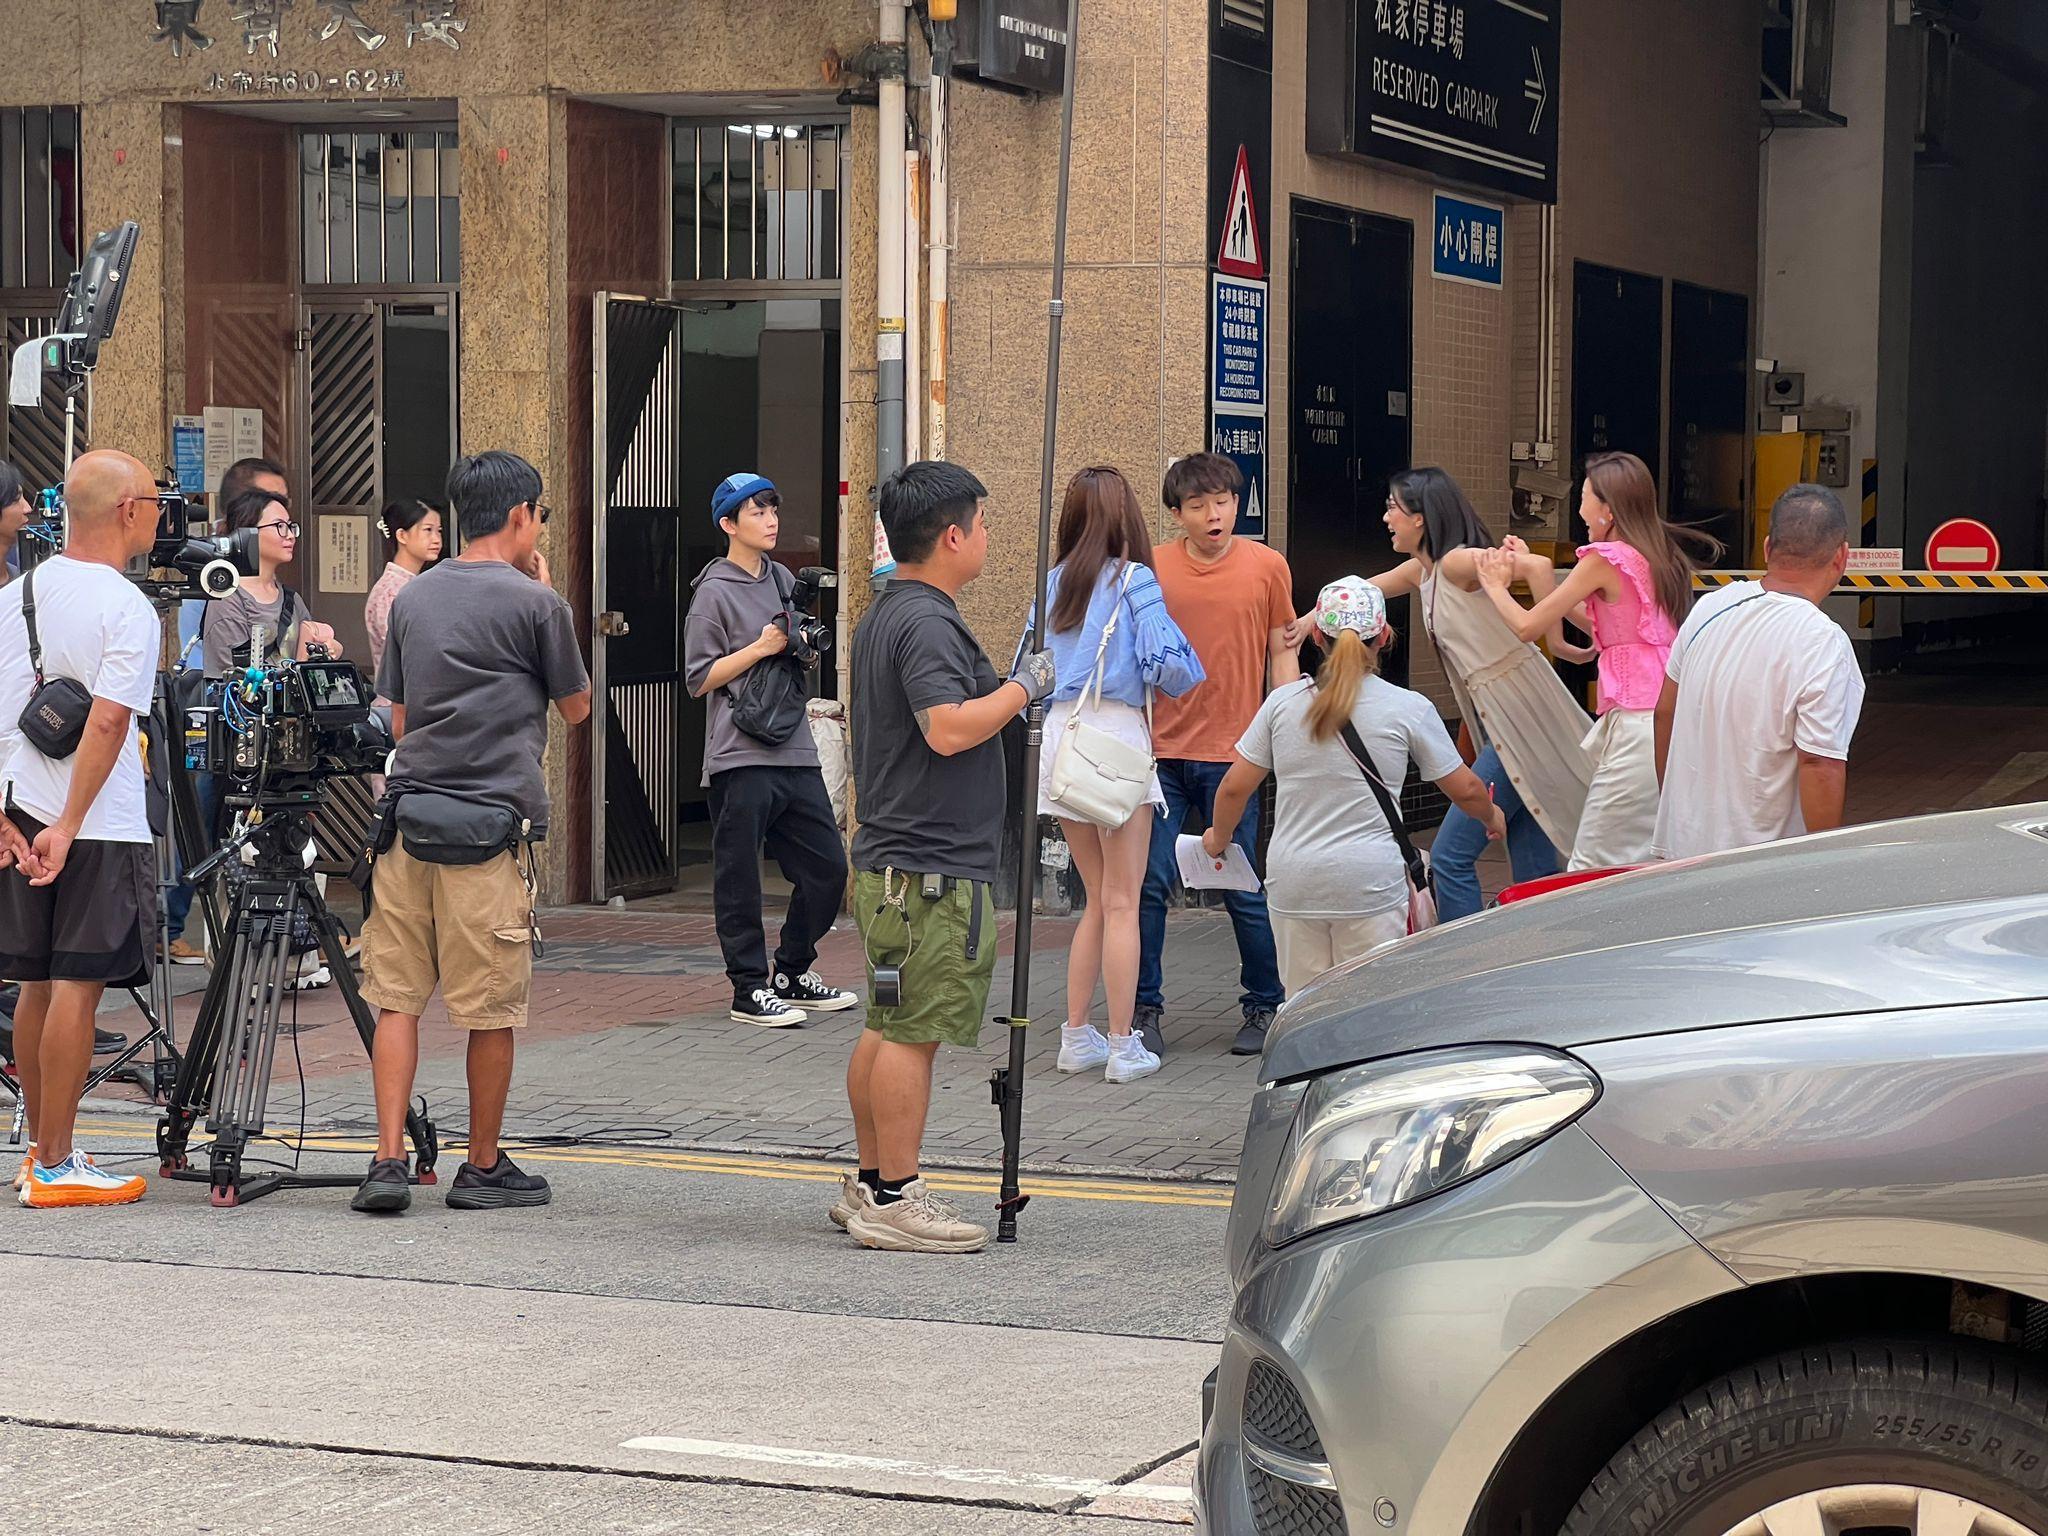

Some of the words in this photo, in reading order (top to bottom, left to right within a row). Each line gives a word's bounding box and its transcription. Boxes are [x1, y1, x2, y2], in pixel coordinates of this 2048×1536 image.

[1373, 56, 1439, 110] RESERVED
[1446, 82, 1499, 129] CARPARK
[1223, 343, 1232, 355] THIS
[1233, 345, 1241, 356] CAR
[1242, 346, 1252, 357] PARK
[1628, 1411, 1834, 1533] MICHELIN
[1873, 1414, 1973, 1448] 255/55
[1981, 1437, 2004, 1458] R
[2012, 1448, 2040, 1473] 18
